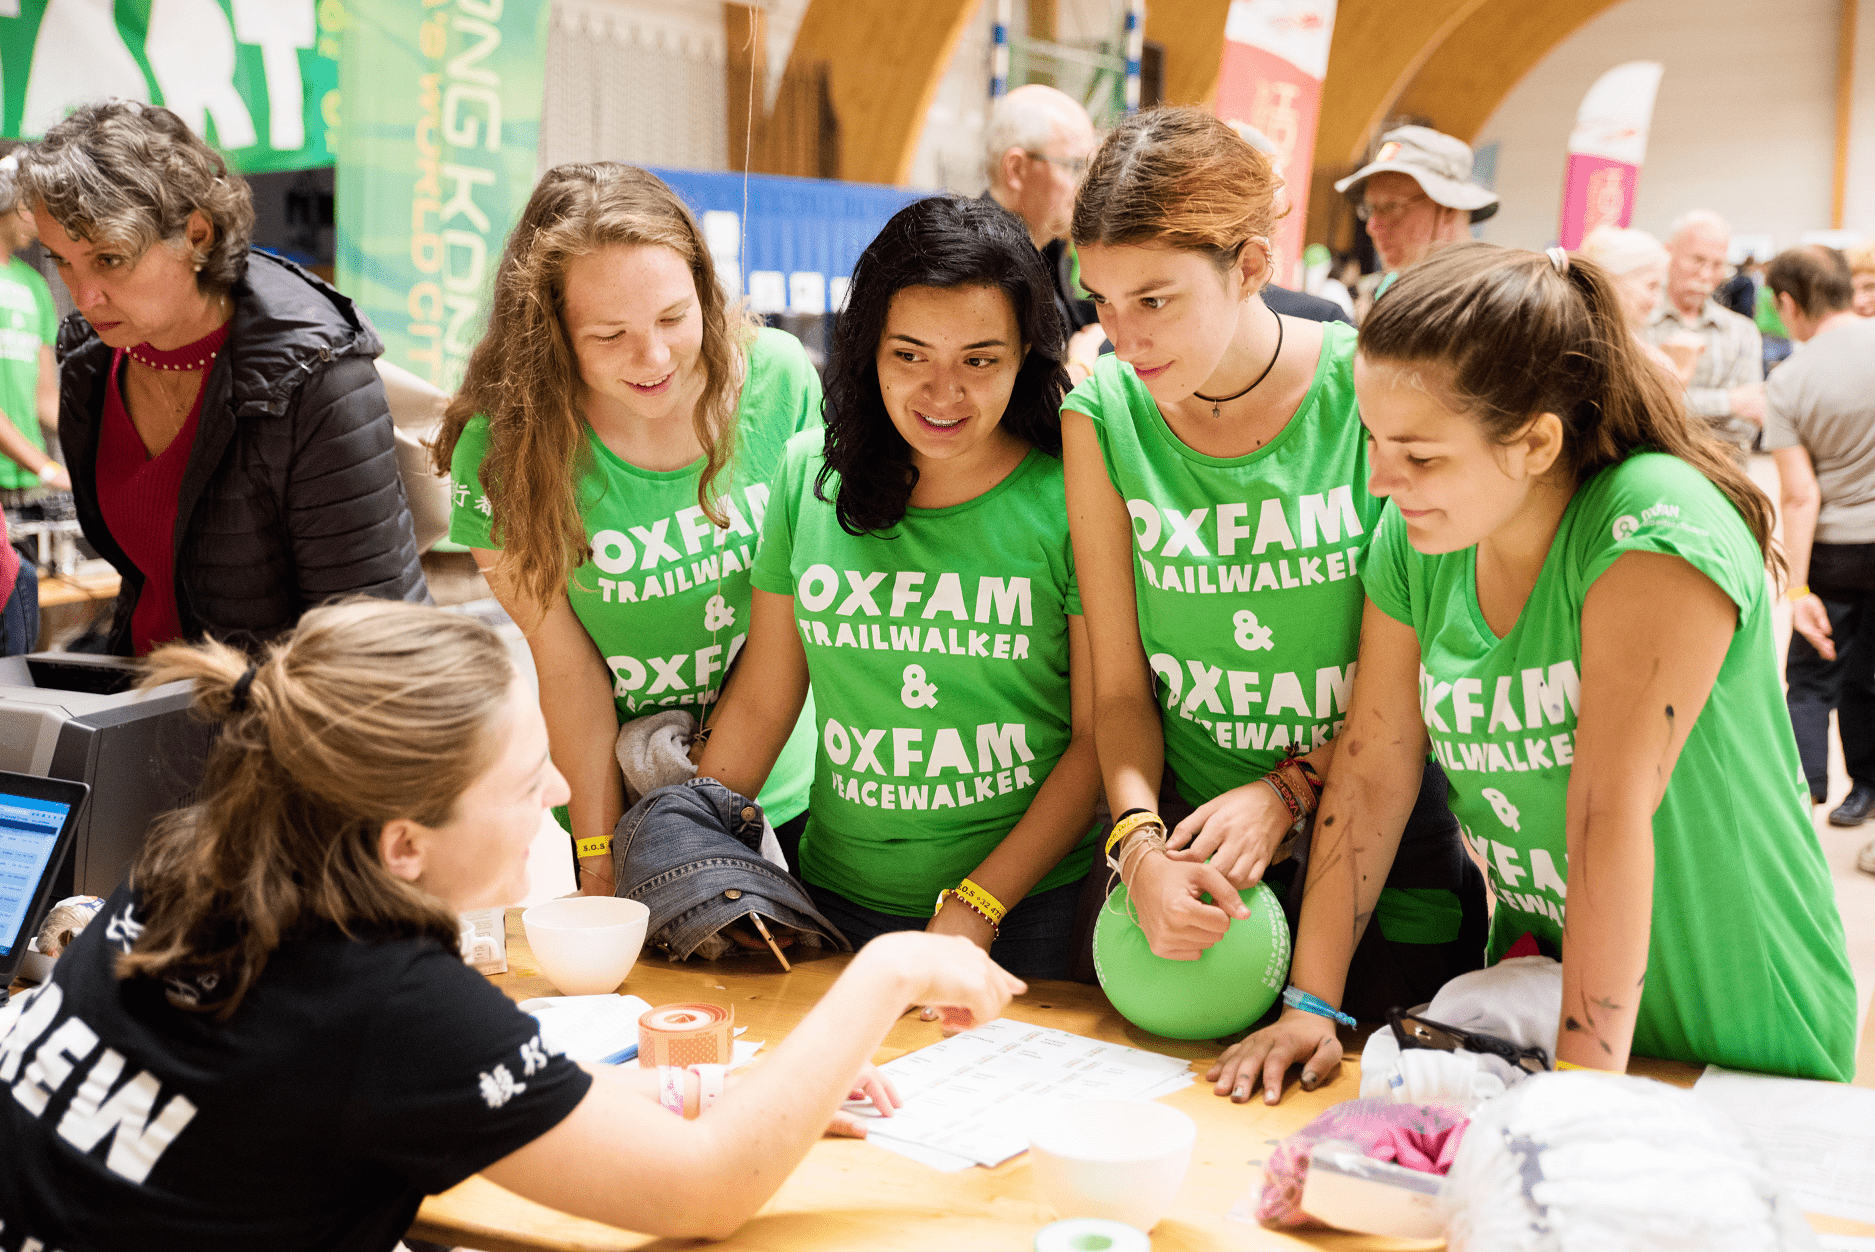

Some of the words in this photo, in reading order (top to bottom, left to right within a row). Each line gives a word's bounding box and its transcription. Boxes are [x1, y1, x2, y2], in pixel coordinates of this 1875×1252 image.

[0, 0, 316, 150] ART
[440, 162, 497, 393] KON
[406, 281, 443, 388] CIT
[1126, 484, 1364, 558] OXFAM
[704, 594, 736, 632] &
[798, 564, 1033, 626] OXFAM
[799, 618, 1030, 660] TRAILWALKER
[1233, 609, 1275, 651] &
[900, 664, 938, 709] &
[824, 718, 1036, 777] OXFAM
[831, 765, 1036, 810] PEACEWALKER
[1481, 787, 1520, 833] &
